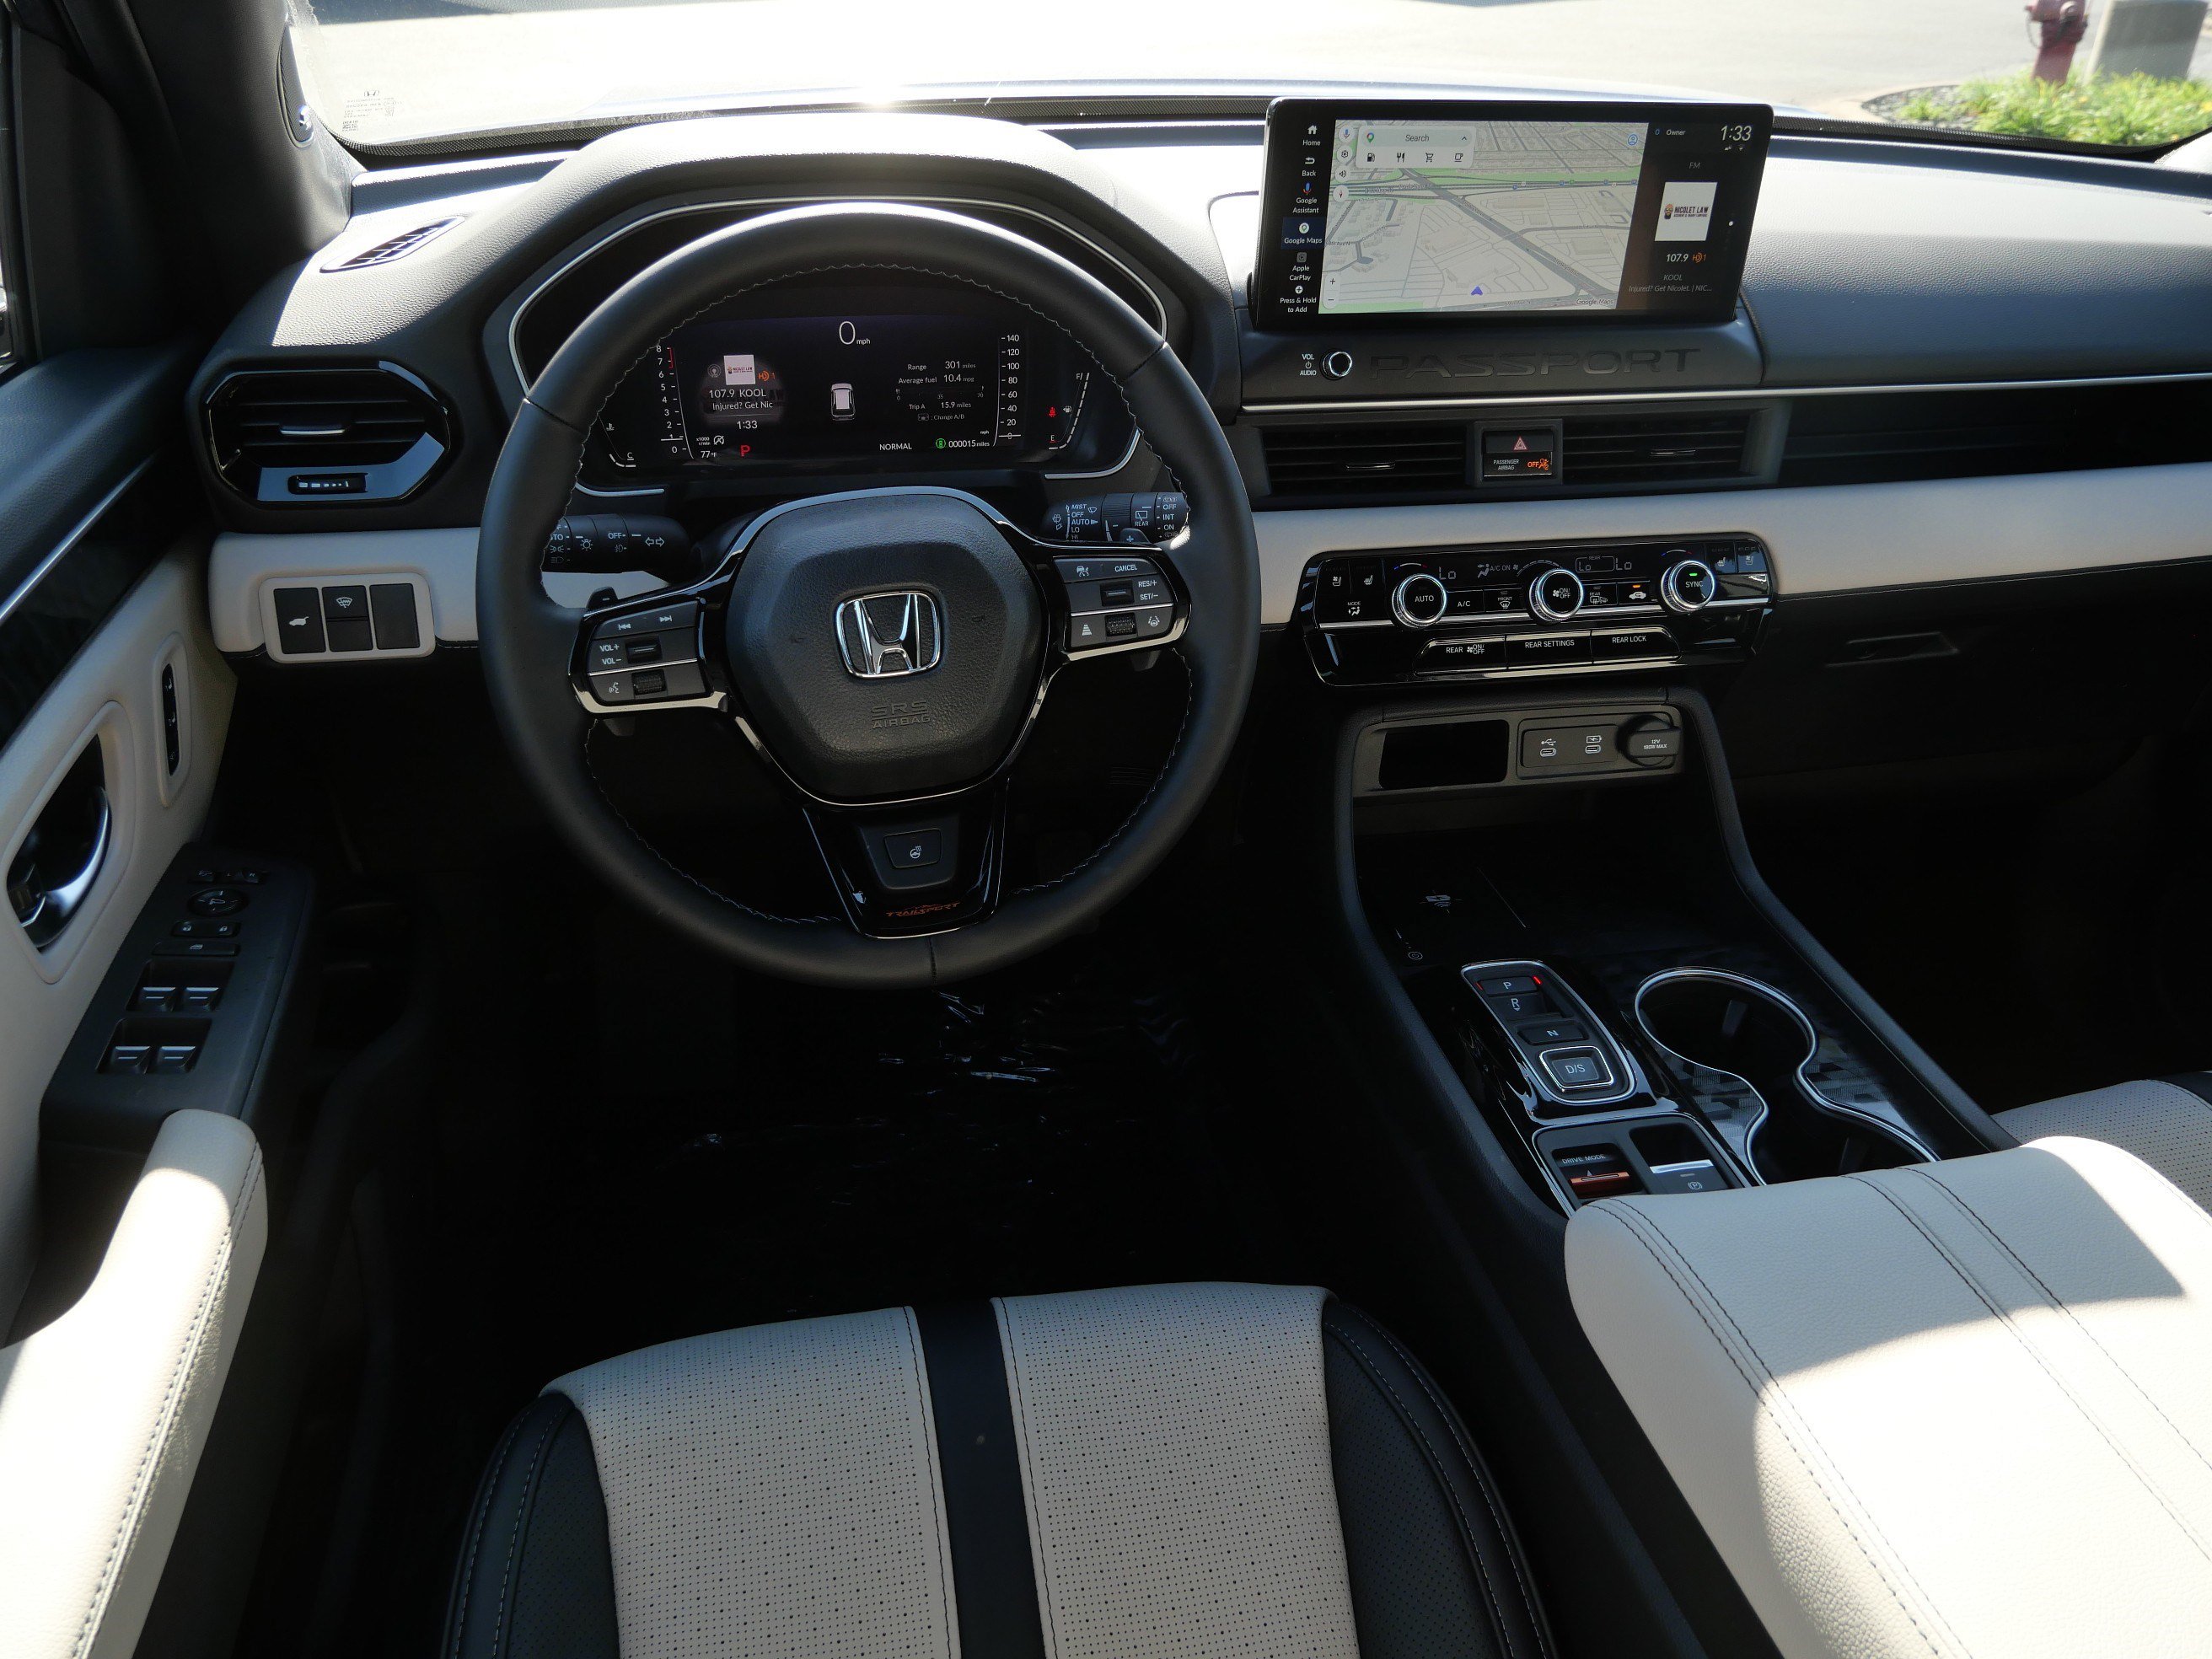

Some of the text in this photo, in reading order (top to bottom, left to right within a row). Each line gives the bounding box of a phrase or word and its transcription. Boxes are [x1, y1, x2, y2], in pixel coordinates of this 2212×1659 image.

[1720, 126, 1753, 142] 1:33
[1284, 237, 1305, 245] Google
[1667, 254, 1689, 262] 107.9
[1629, 285, 1652, 293] Injured?
[839, 321, 856, 345] 0
[907, 363, 926, 372] Range
[945, 361, 961, 369] 301
[1368, 349, 1700, 380] PASSPORT
[898, 377, 922, 385] Average
[944, 374, 961, 383] 10.4
[709, 389, 766, 399] 107.9 KOOL
[712, 402, 743, 411] Injured?
[737, 421, 758, 430] 1:33
[879, 443, 912, 452] NORMAL
[948, 439, 976, 448] 000015
[740, 445, 750, 457] P
[1114, 564, 1137, 572] CANCEL
[871, 701, 927, 717] SRS
[872, 716, 931, 729] AIRBAG
[1503, 981, 1511, 990] P
[1511, 998, 1519, 1007] R
[1565, 1064, 1586, 1073] D/S
